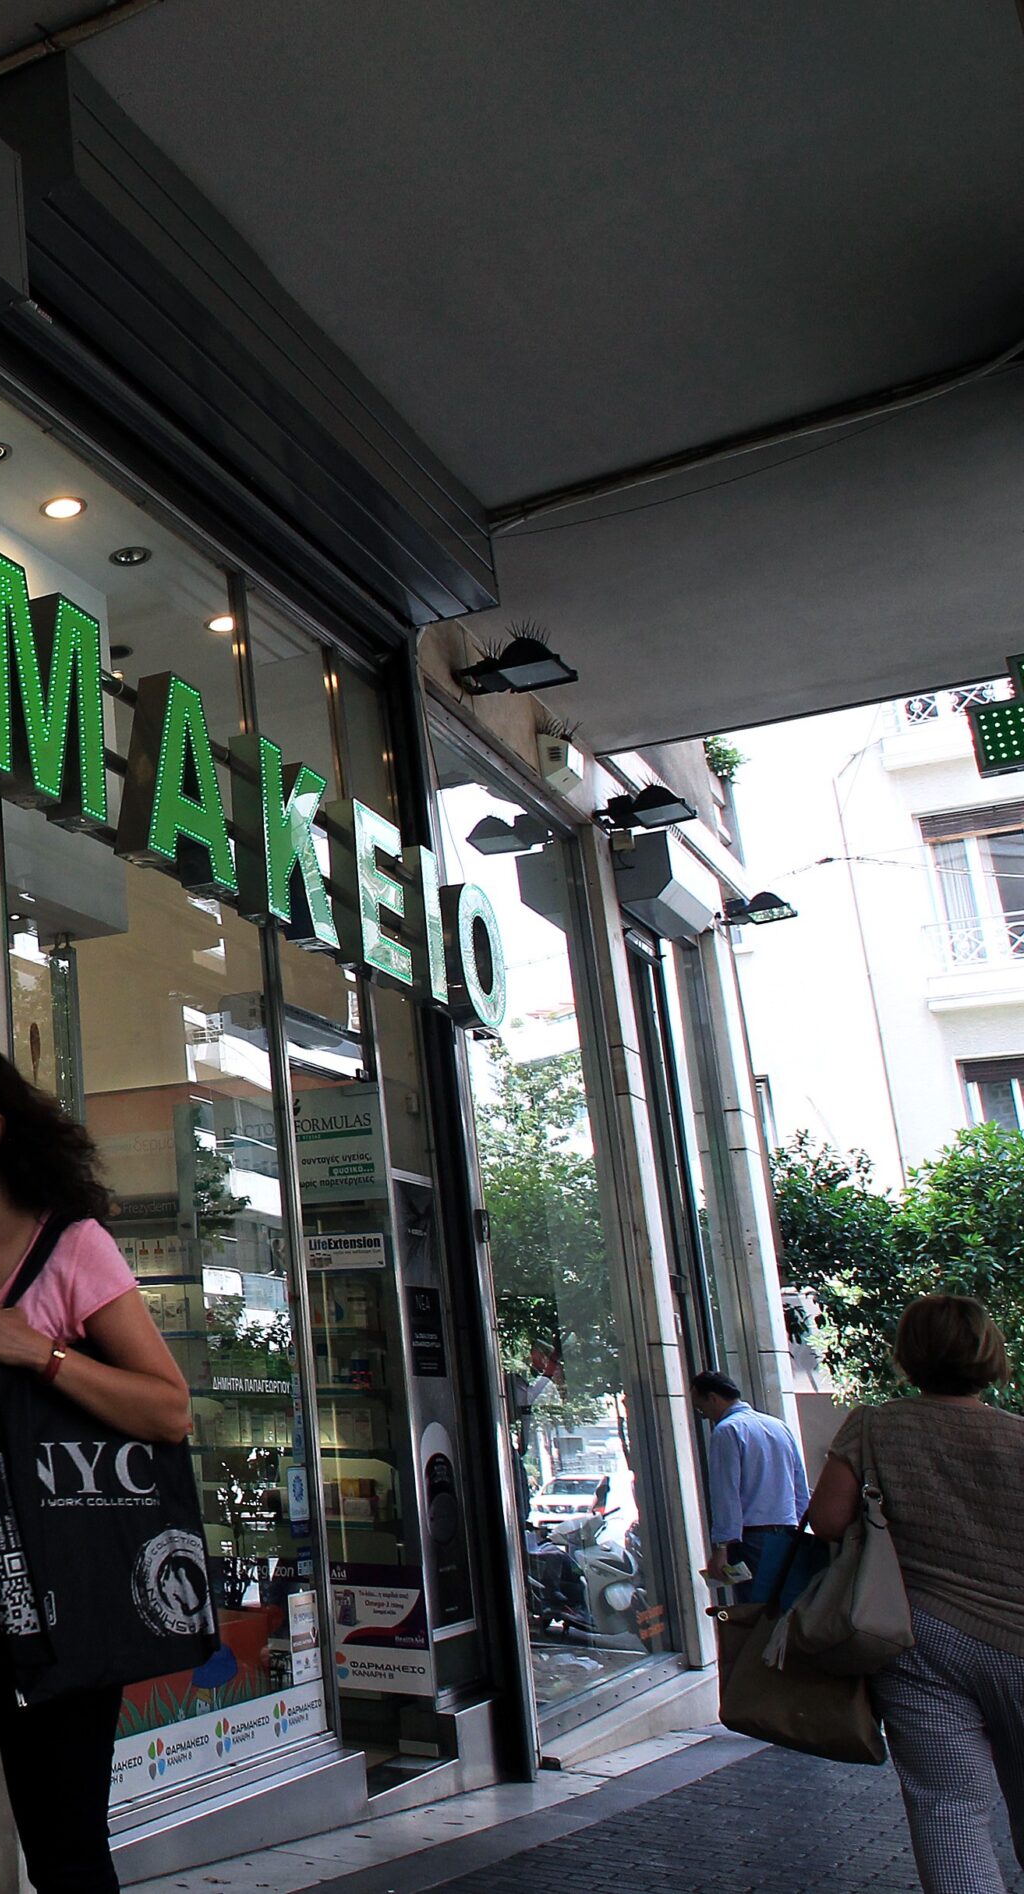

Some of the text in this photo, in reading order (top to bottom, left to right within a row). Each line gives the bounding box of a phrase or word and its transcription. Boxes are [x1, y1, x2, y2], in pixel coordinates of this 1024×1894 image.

[308, 1236, 381, 1251] LifeExtension
[349, 1661, 426, 1675] ΦΑΡΜΑΚΕΙΟ
[287, 1698, 322, 1717] ΦΑΡΜΑΚΕΙΟ
[230, 1715, 270, 1736] ΦΑΡΜΑΚΕΙΟ
[165, 1734, 210, 1757] ΦΑΡΜΑΚΕΙΟ
